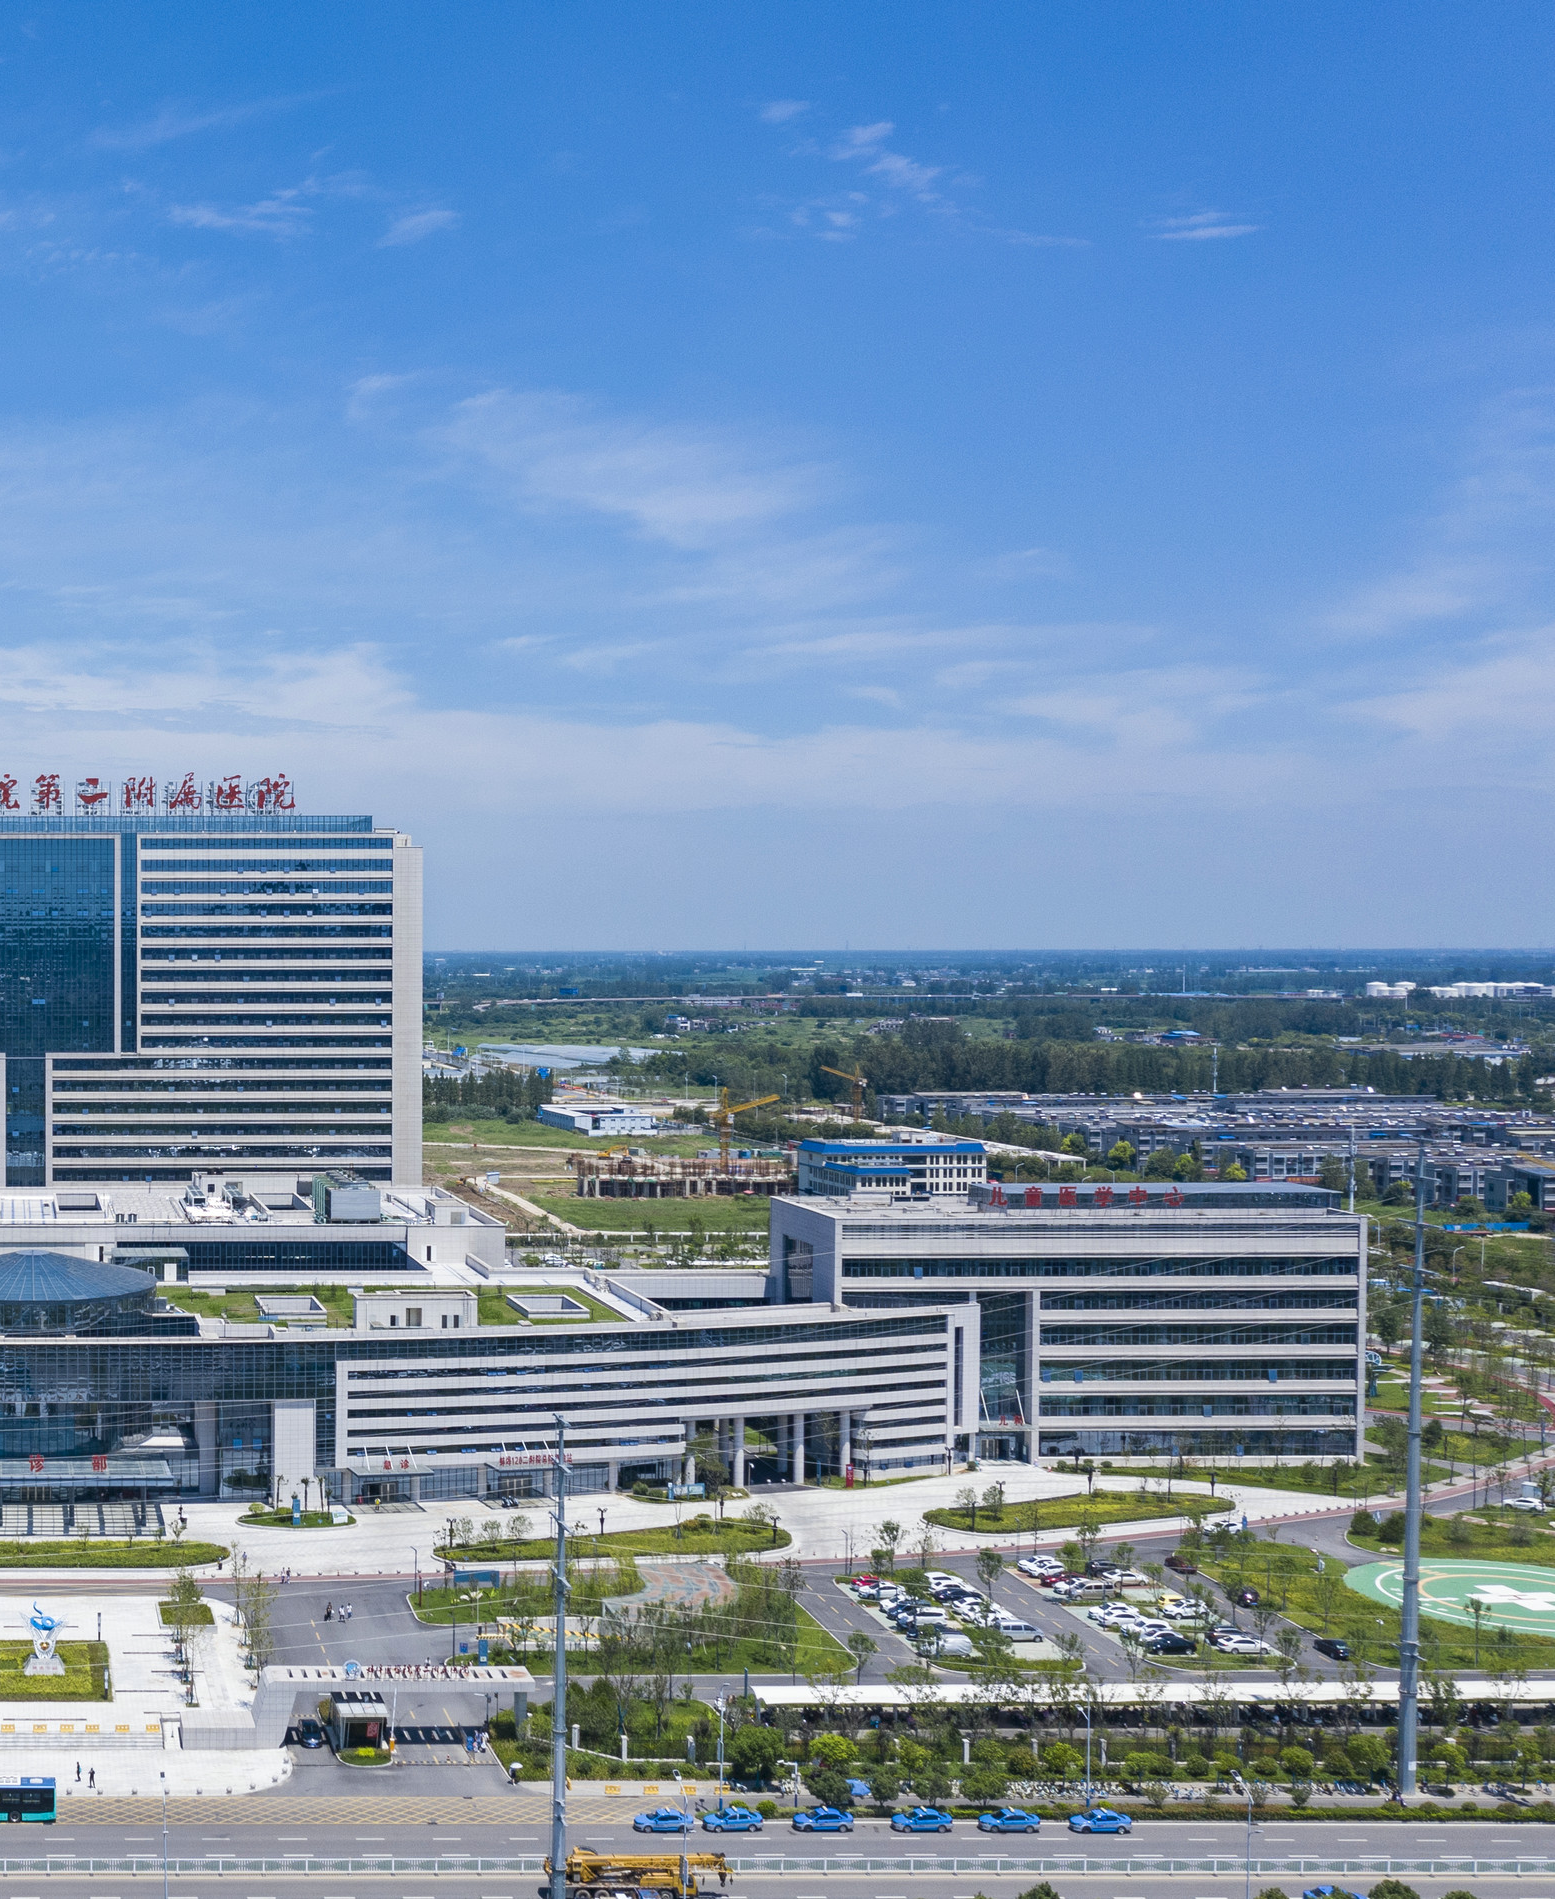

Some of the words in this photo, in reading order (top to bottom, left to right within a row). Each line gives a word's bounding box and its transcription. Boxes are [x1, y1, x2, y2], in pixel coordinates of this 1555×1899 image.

[989, 1186, 1185, 1208] 儿童医学中心
[383, 1459, 410, 1471] 急诊
